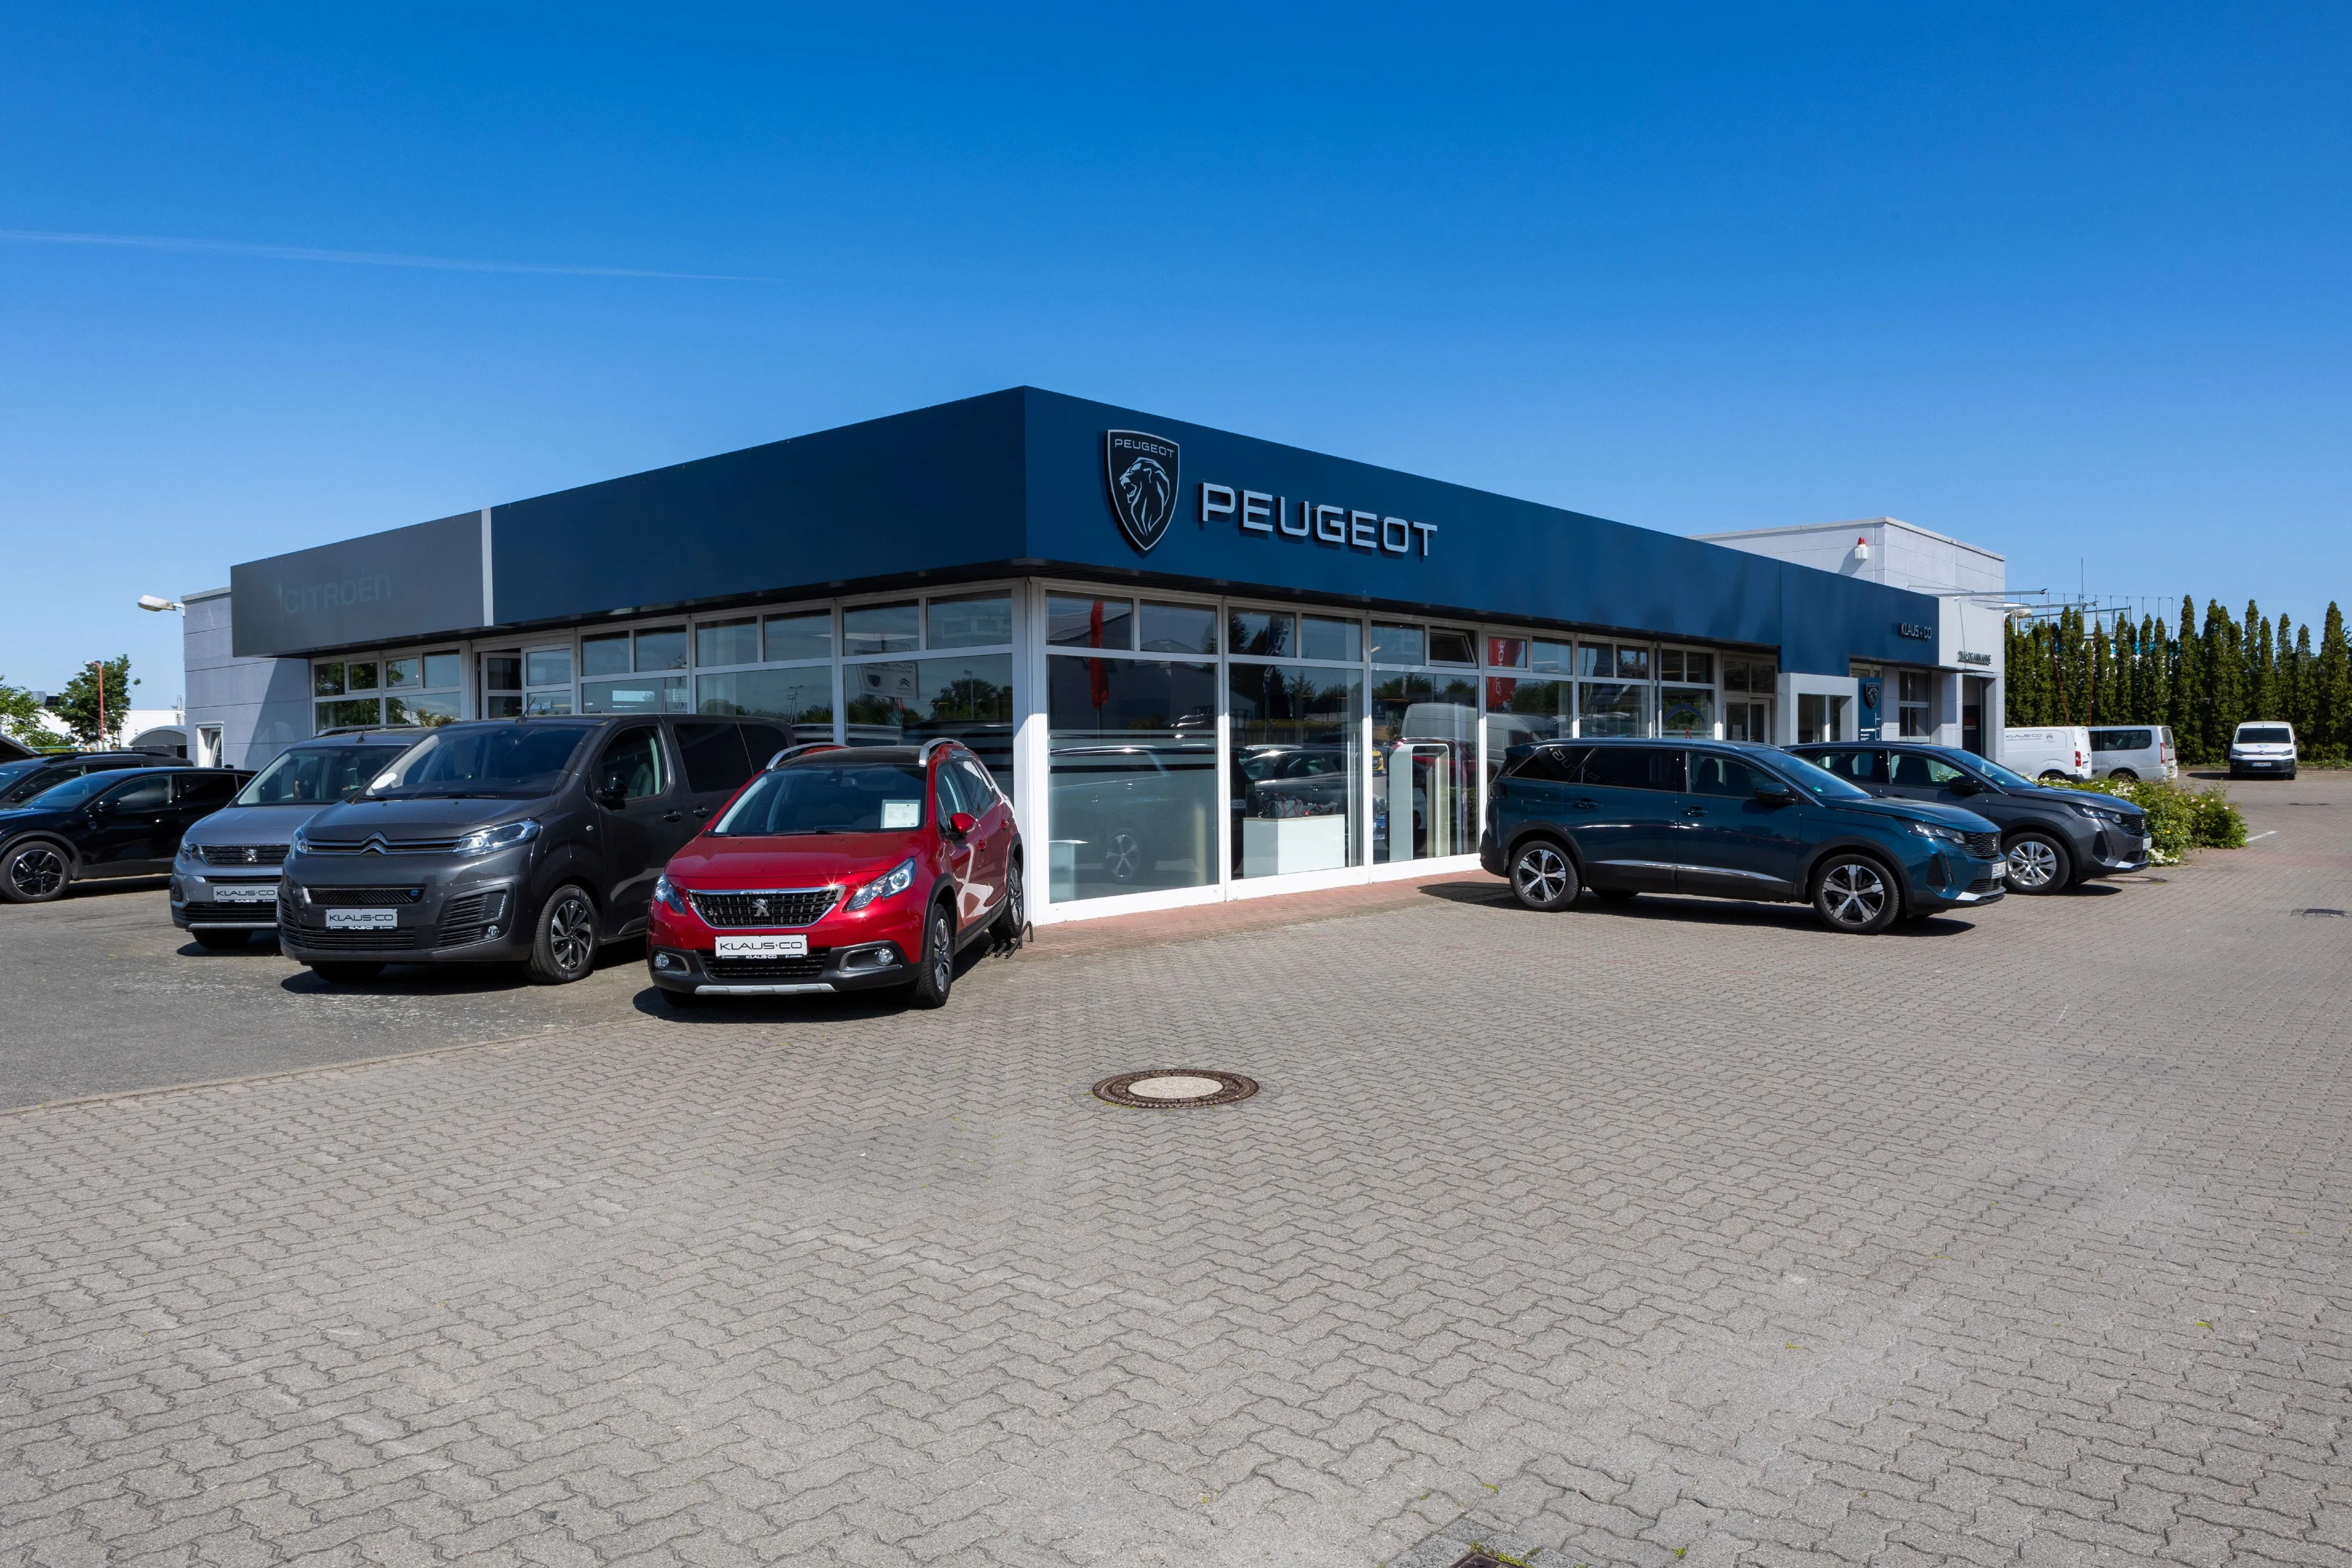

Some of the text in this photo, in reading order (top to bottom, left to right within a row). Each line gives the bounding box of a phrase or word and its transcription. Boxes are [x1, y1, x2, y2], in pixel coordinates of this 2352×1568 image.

[1115, 439, 1174, 458] PEUGEOT
[1202, 482, 1438, 556] PEUGEOT
[1900, 622, 1919, 637] KLAUS
[1923, 626, 1932, 639] CO
[720, 941, 802, 950] KLAUS+CO
